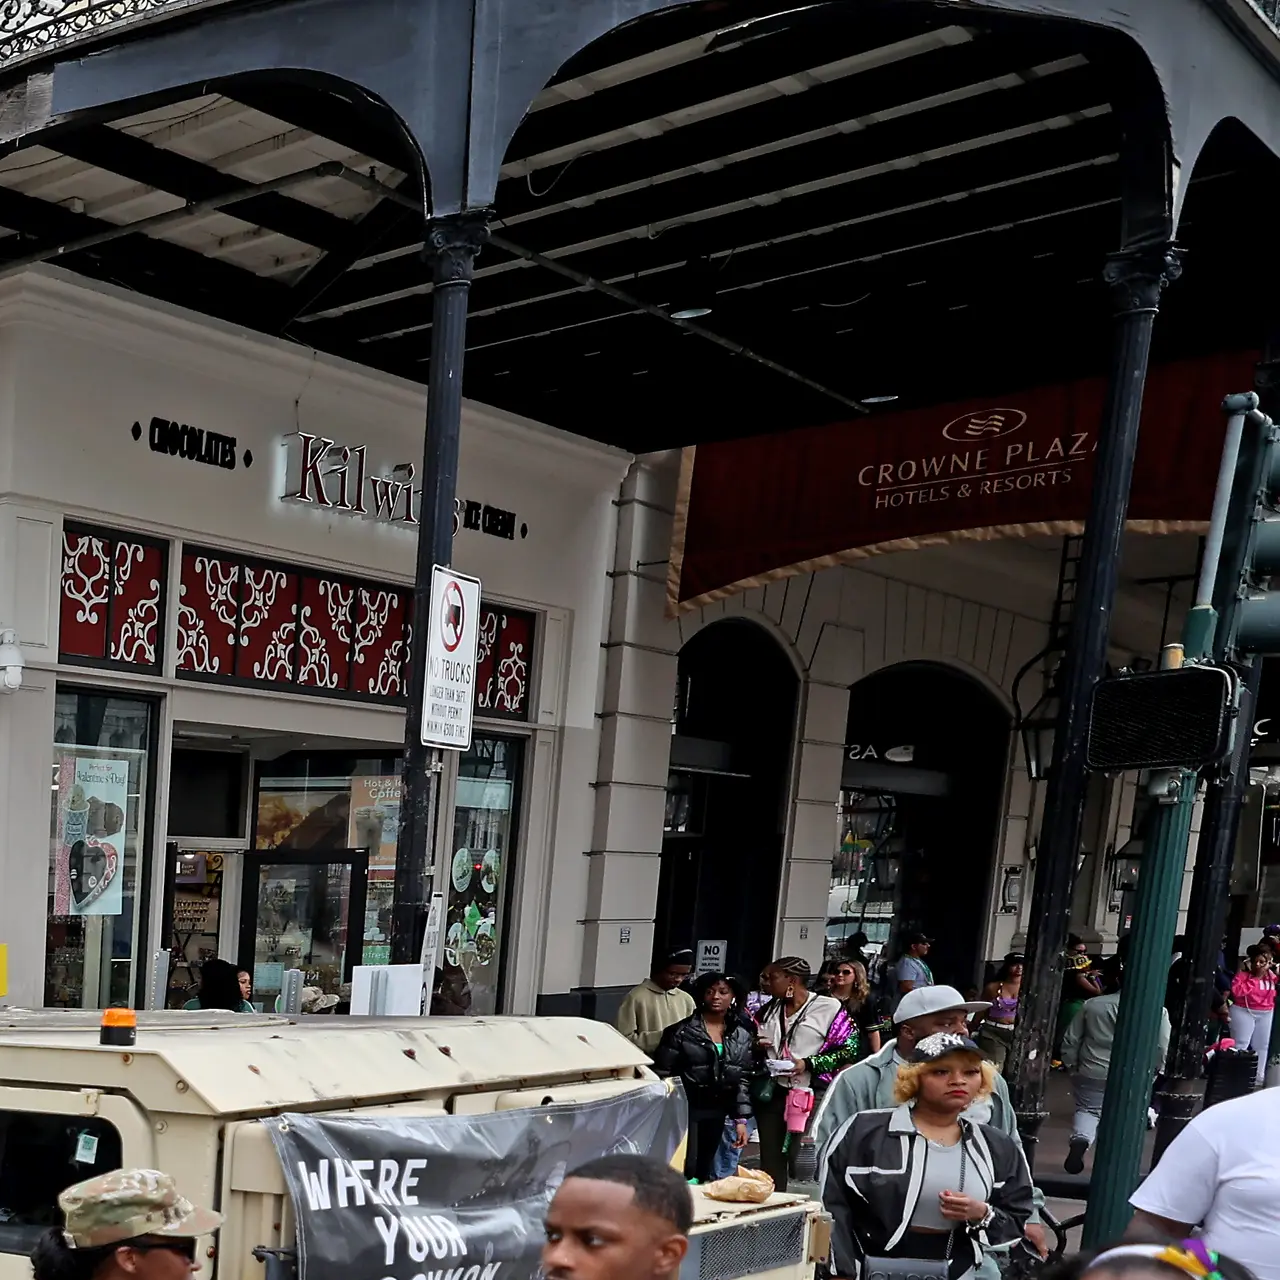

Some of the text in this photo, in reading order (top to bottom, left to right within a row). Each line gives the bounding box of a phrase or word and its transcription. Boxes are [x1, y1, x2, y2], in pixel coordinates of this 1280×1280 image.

[148, 416, 237, 470] CHOCOLATES
[858, 432, 1098, 487] CROWNE PLAZ
[875, 468, 1072, 509] HOTELS & RESORTS
[429, 655, 472, 685] NO TRUCKS
[364, 779, 381, 788] Hot
[369, 788, 401, 799] Coffe
[704, 945, 720, 956] NO
[298, 1158, 427, 1211] WHERE
[374, 1215, 468, 1265] YOUR
